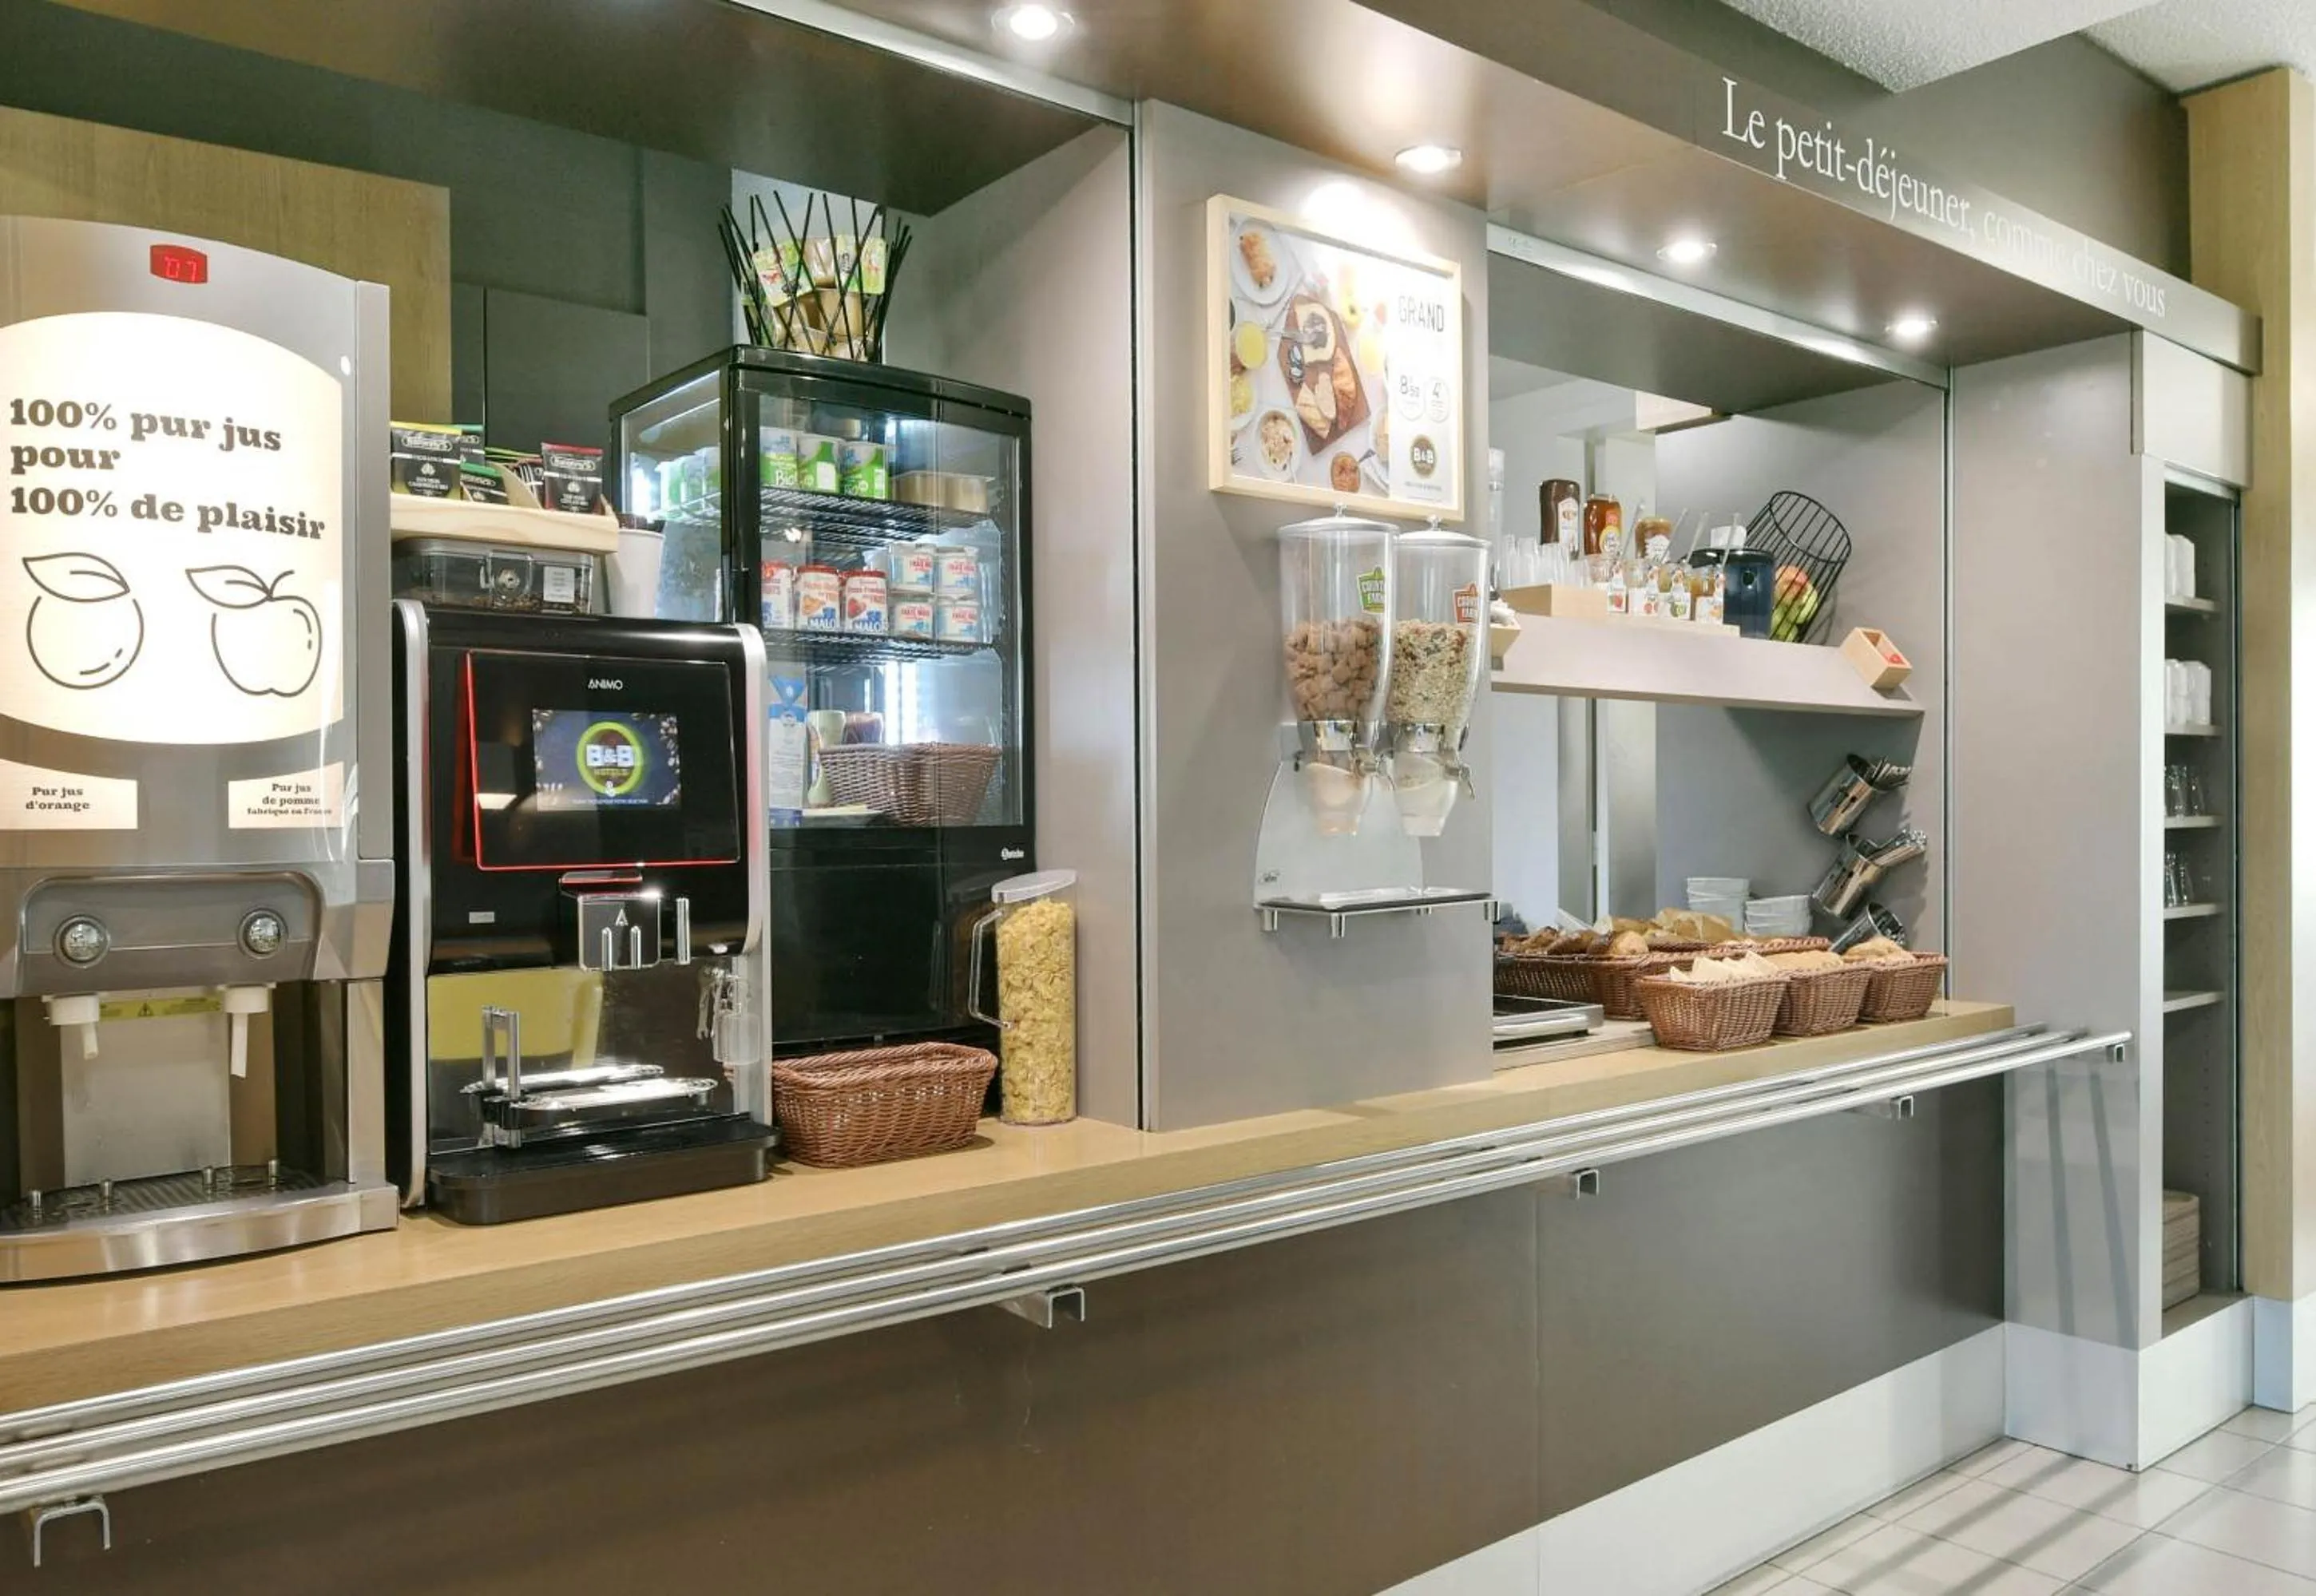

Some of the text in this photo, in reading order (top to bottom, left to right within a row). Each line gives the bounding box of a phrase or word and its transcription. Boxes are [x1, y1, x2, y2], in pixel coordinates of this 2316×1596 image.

[1722, 77, 2166, 318] Le petit-déjeuner, comme chez vous
[1398, 295, 1445, 333] GRAND
[10, 398, 282, 451] 100% pur jus
[10, 444, 121, 475] pour
[10, 486, 326, 540] 100% de plaisir
[588, 679, 623, 690] ANIMO
[585, 743, 634, 767] B&B
[32, 786, 84, 798] Pur jus
[272, 783, 311, 794] Pur jus
[26, 800, 91, 812] d'orange
[262, 796, 320, 806] de pomme
